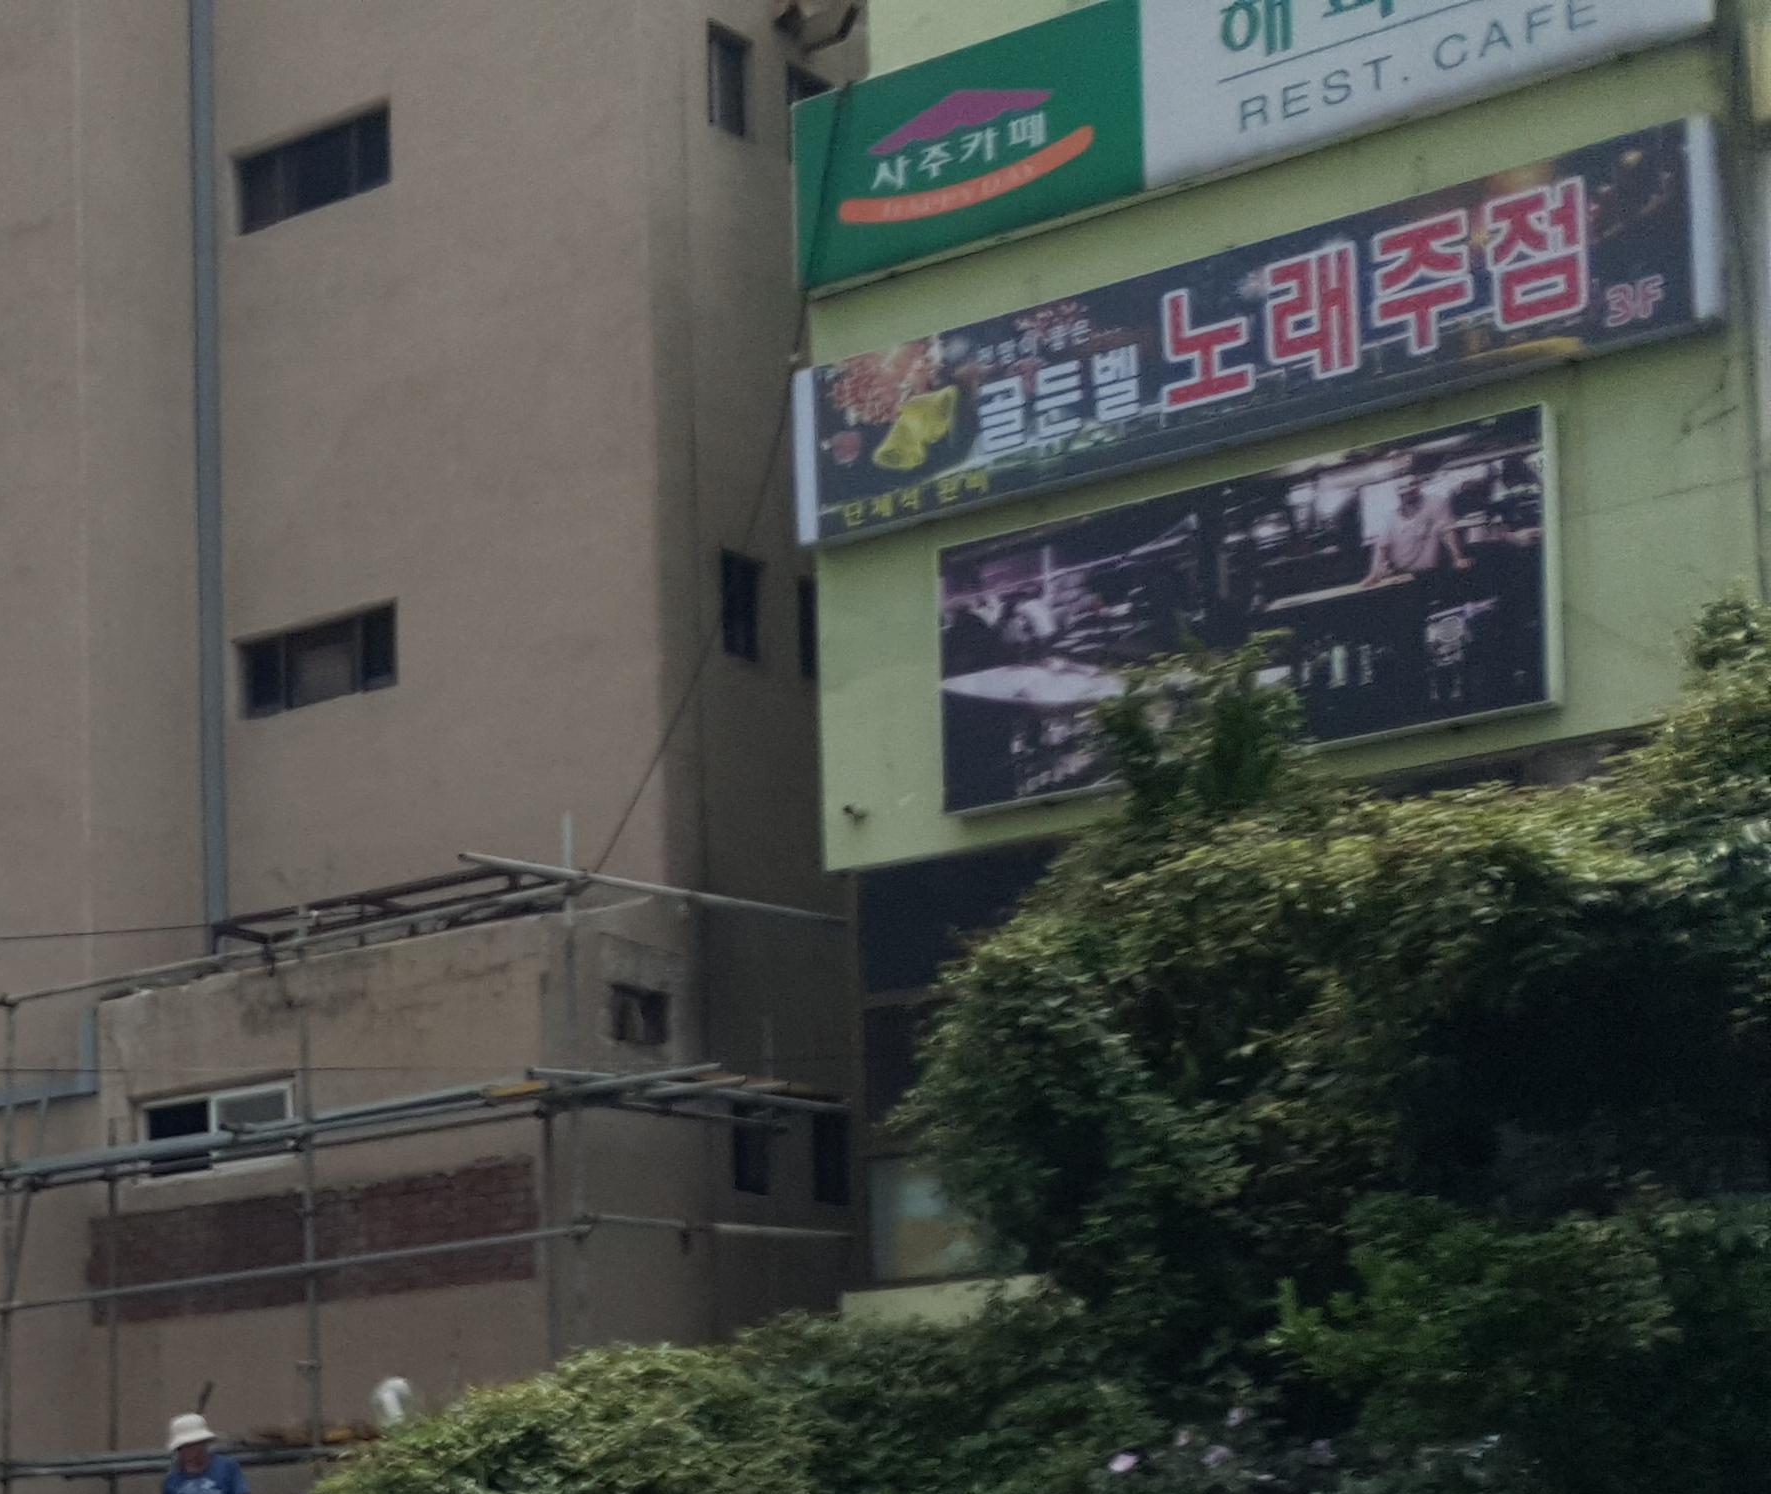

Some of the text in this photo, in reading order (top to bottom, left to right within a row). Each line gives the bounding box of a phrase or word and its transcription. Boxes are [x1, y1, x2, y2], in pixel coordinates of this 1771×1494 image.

[1240, 0, 1599, 132] REST. CAFE
[870, 112, 1049, 191] 사주카페
[977, 175, 1589, 458] 골든벨 노래주점
[1604, 273, 1666, 329] 3F
